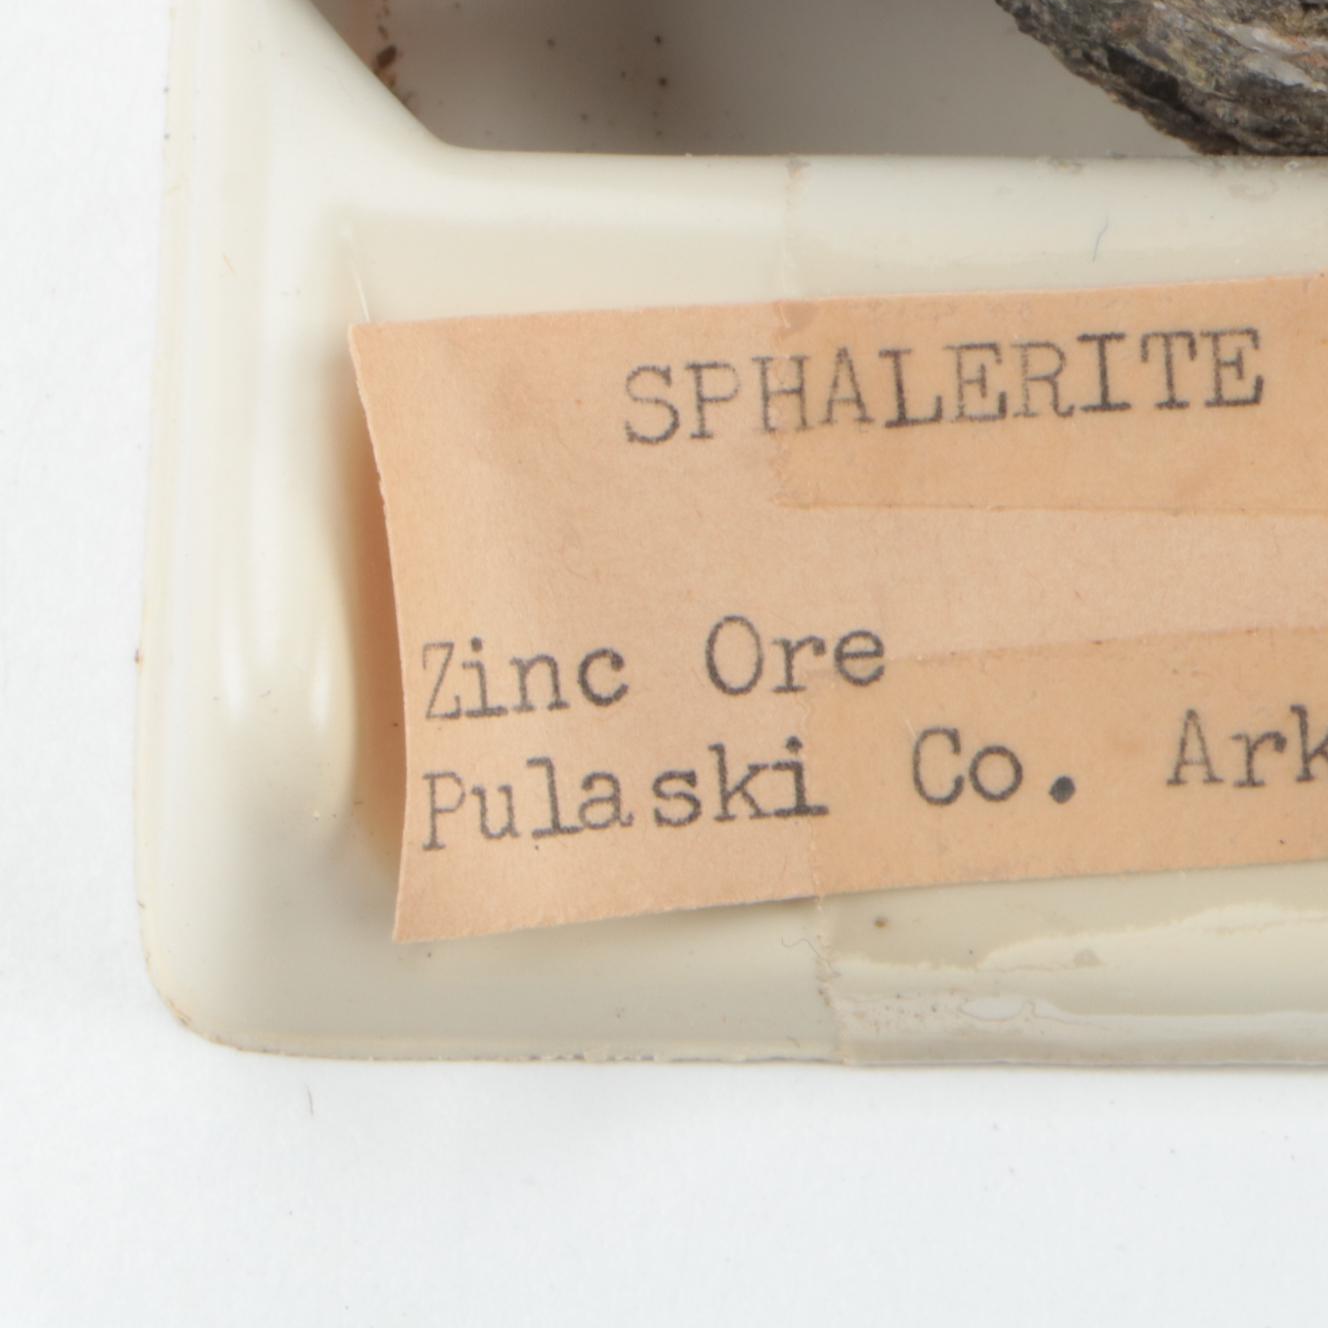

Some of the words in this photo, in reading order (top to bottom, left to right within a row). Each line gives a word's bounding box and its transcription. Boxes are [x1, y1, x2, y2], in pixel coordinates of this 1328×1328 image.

[624, 326, 1266, 446] SPHALERITE
[424, 636, 630, 722] Zinc
[703, 614, 886, 698] Ore
[421, 738, 831, 853] Pulaski
[911, 726, 1077, 808] Co.
